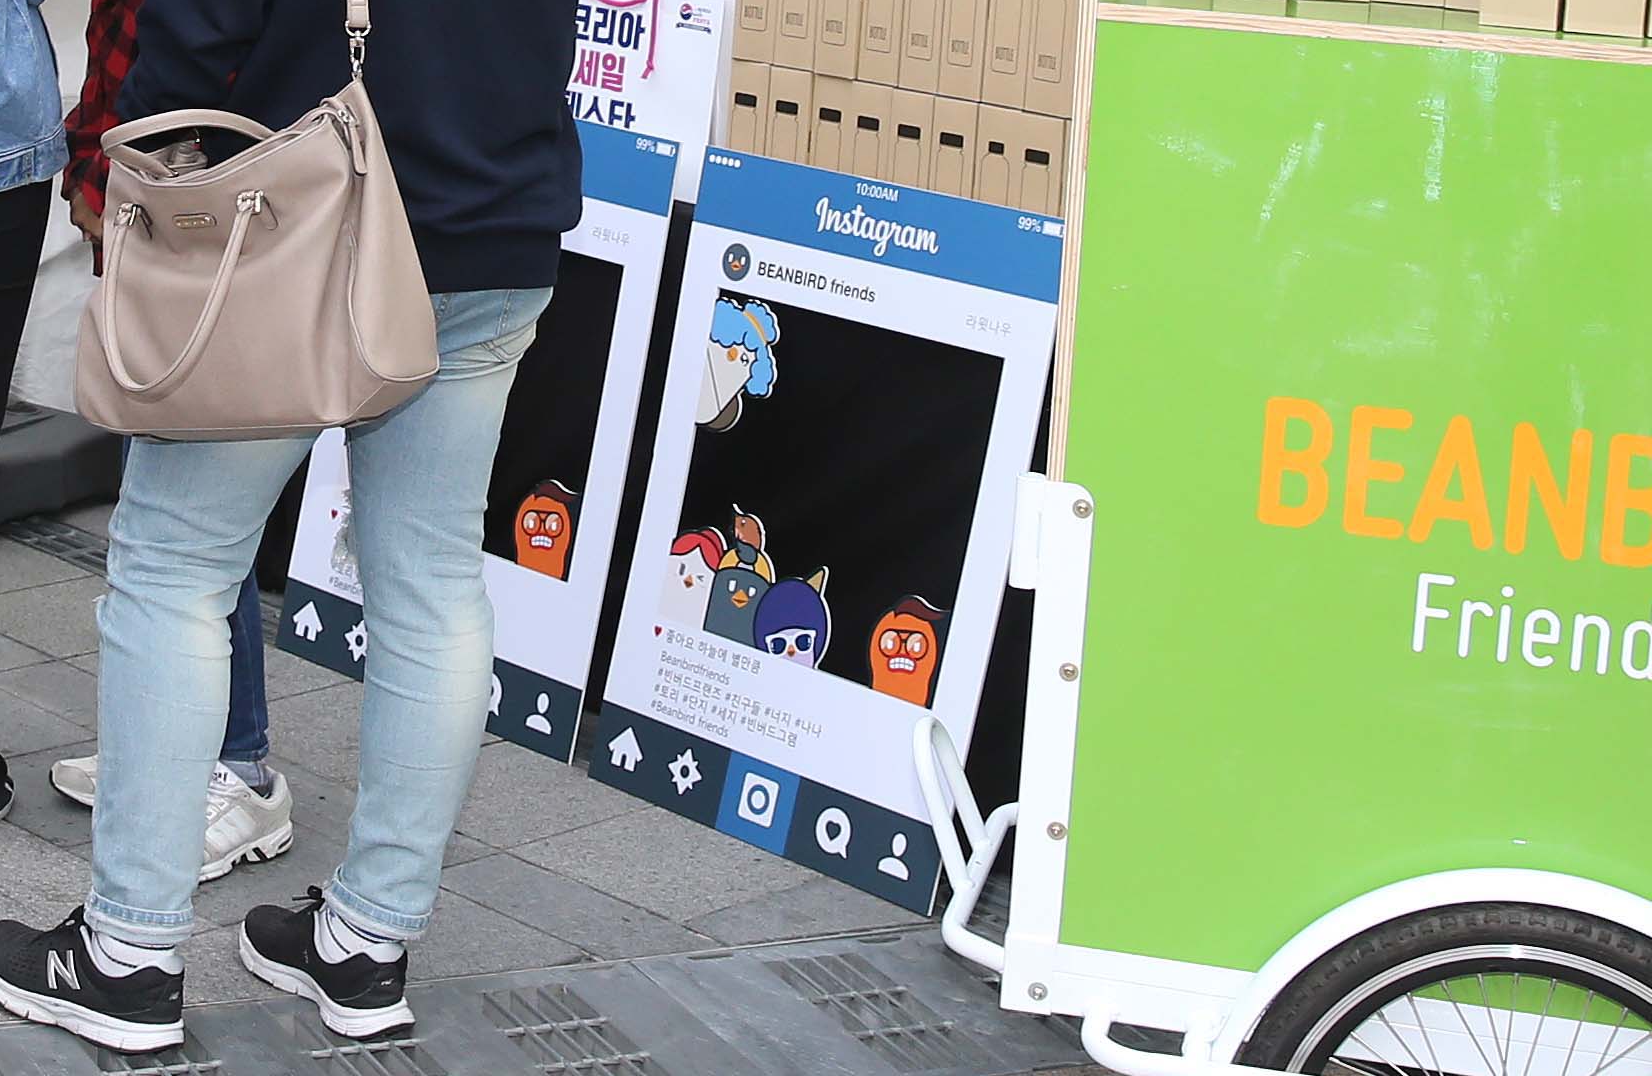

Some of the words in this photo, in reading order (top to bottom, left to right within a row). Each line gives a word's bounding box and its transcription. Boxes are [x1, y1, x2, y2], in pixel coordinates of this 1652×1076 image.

[574, 4, 646, 51] 코리아
[572, 48, 627, 94] 세일
[635, 136, 657, 154] 99%
[854, 182, 899, 203] 10:00AM
[814, 196, 940, 257] Instagram
[1017, 215, 1042, 234] 99%
[757, 261, 828, 291] BEANBIRD
[829, 278, 877, 303] friends
[1257, 396, 1652, 569] BEANB
